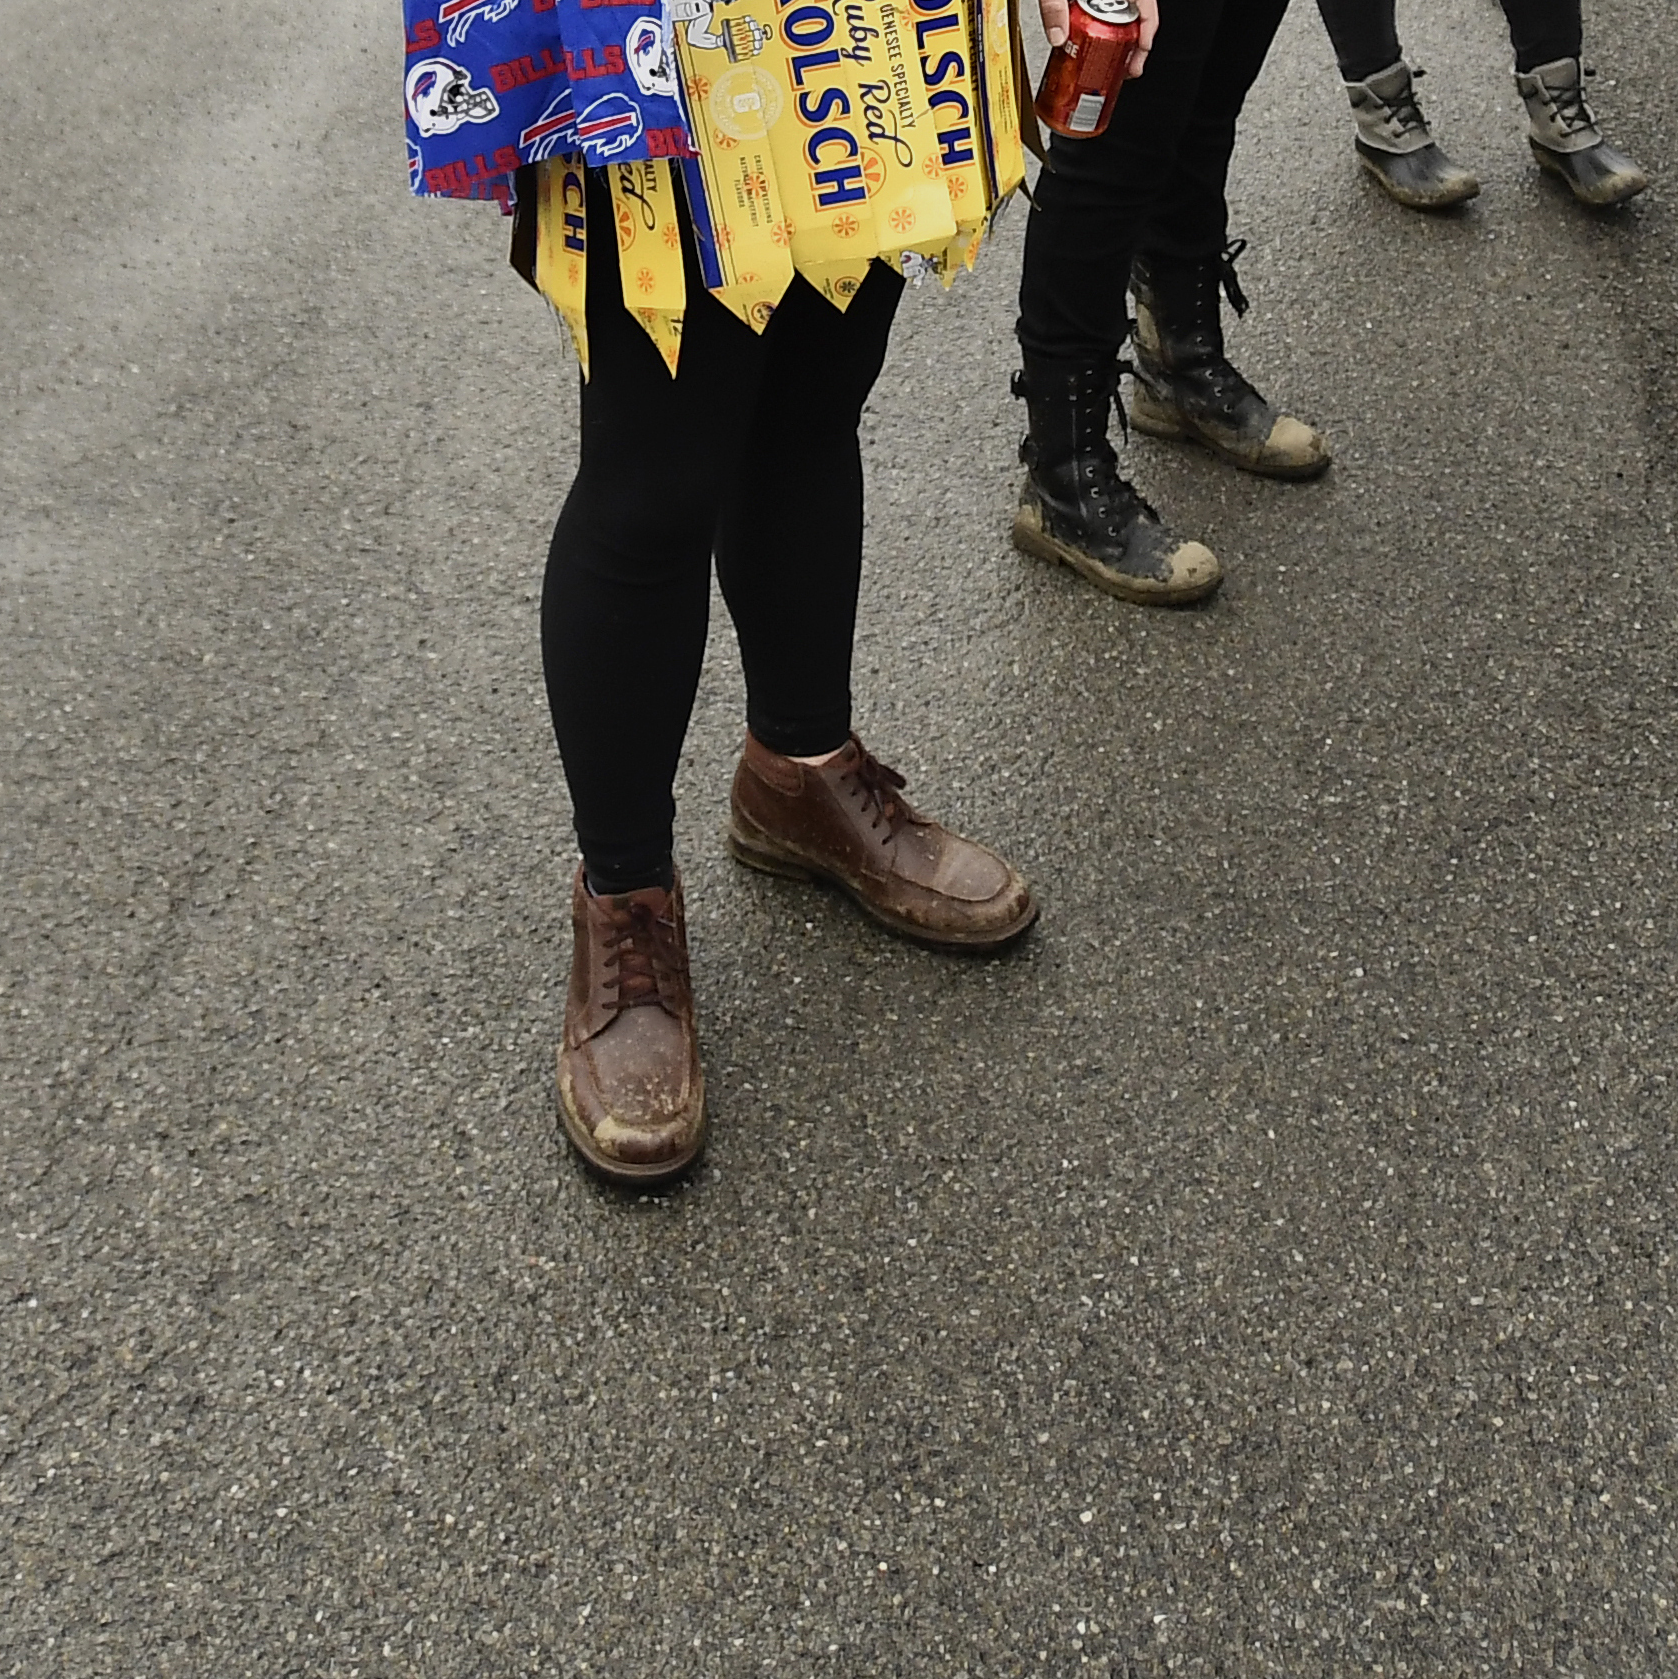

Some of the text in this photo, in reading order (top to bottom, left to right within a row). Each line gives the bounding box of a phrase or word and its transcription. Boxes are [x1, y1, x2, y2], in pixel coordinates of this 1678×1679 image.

[858, 79, 913, 168] Red
[894, 65, 917, 129] SPECIALTY
[424, 145, 521, 194] BILLS
